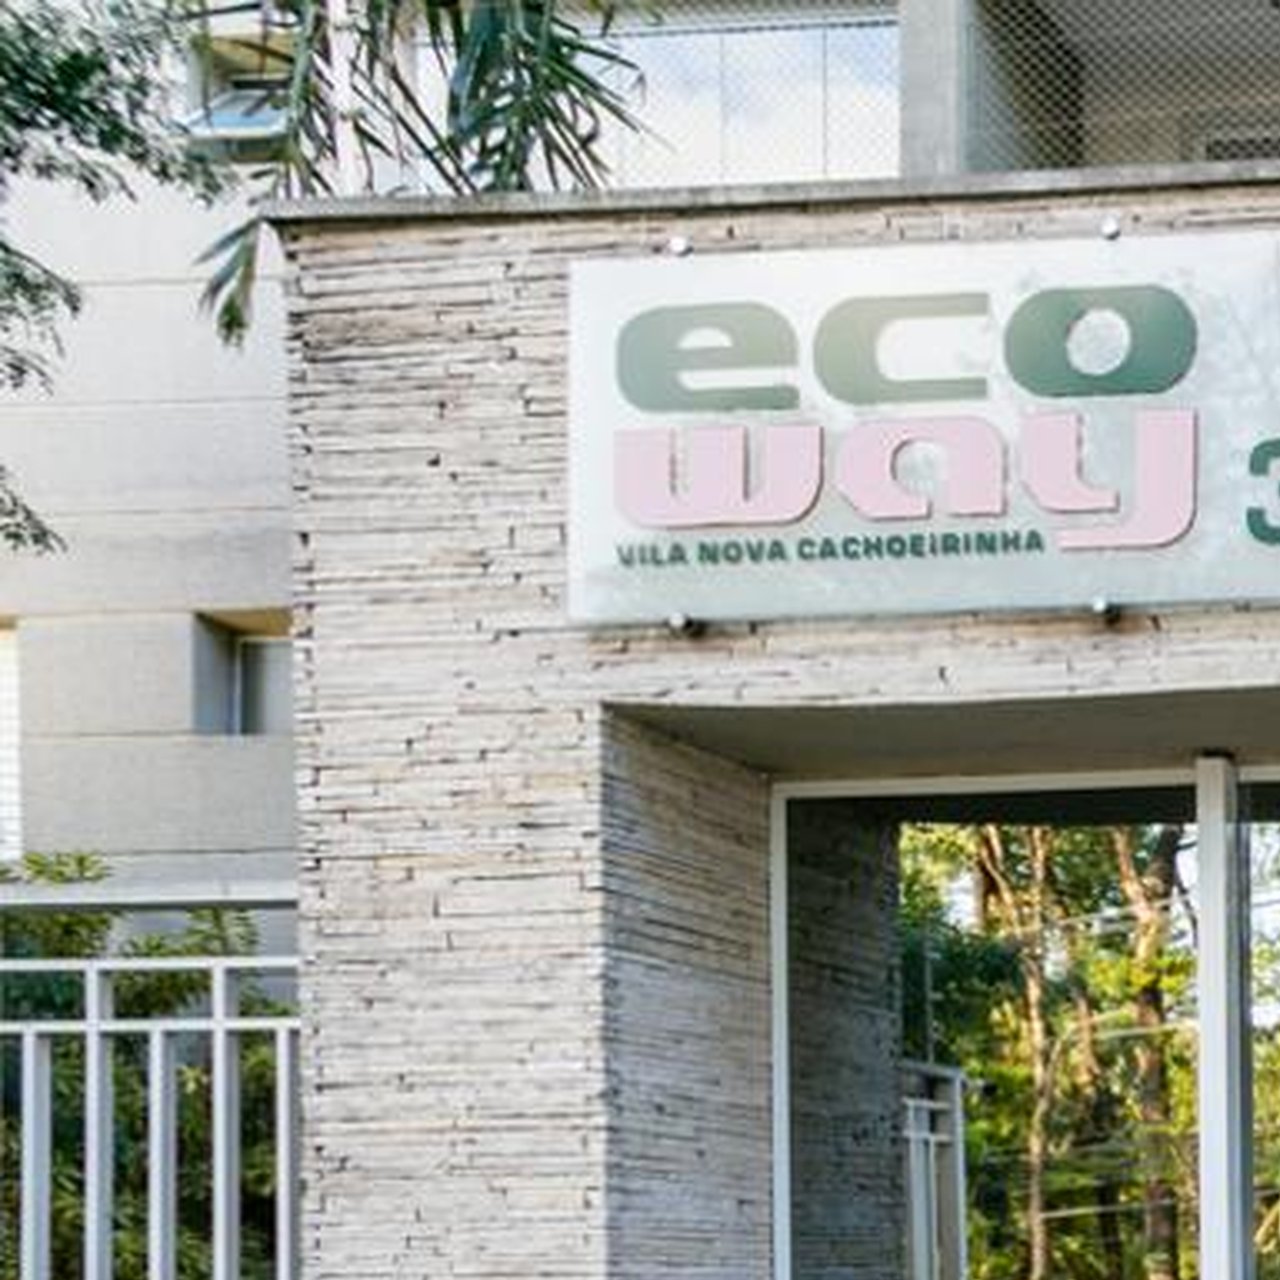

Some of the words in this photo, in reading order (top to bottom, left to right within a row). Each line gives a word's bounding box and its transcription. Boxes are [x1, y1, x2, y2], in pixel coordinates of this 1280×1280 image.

[614, 284, 1198, 411] eco
[613, 408, 1198, 551] way
[617, 544, 689, 567] VILA
[699, 539, 788, 565] NOVA
[799, 530, 1046, 561] CACHOEIRINHA
